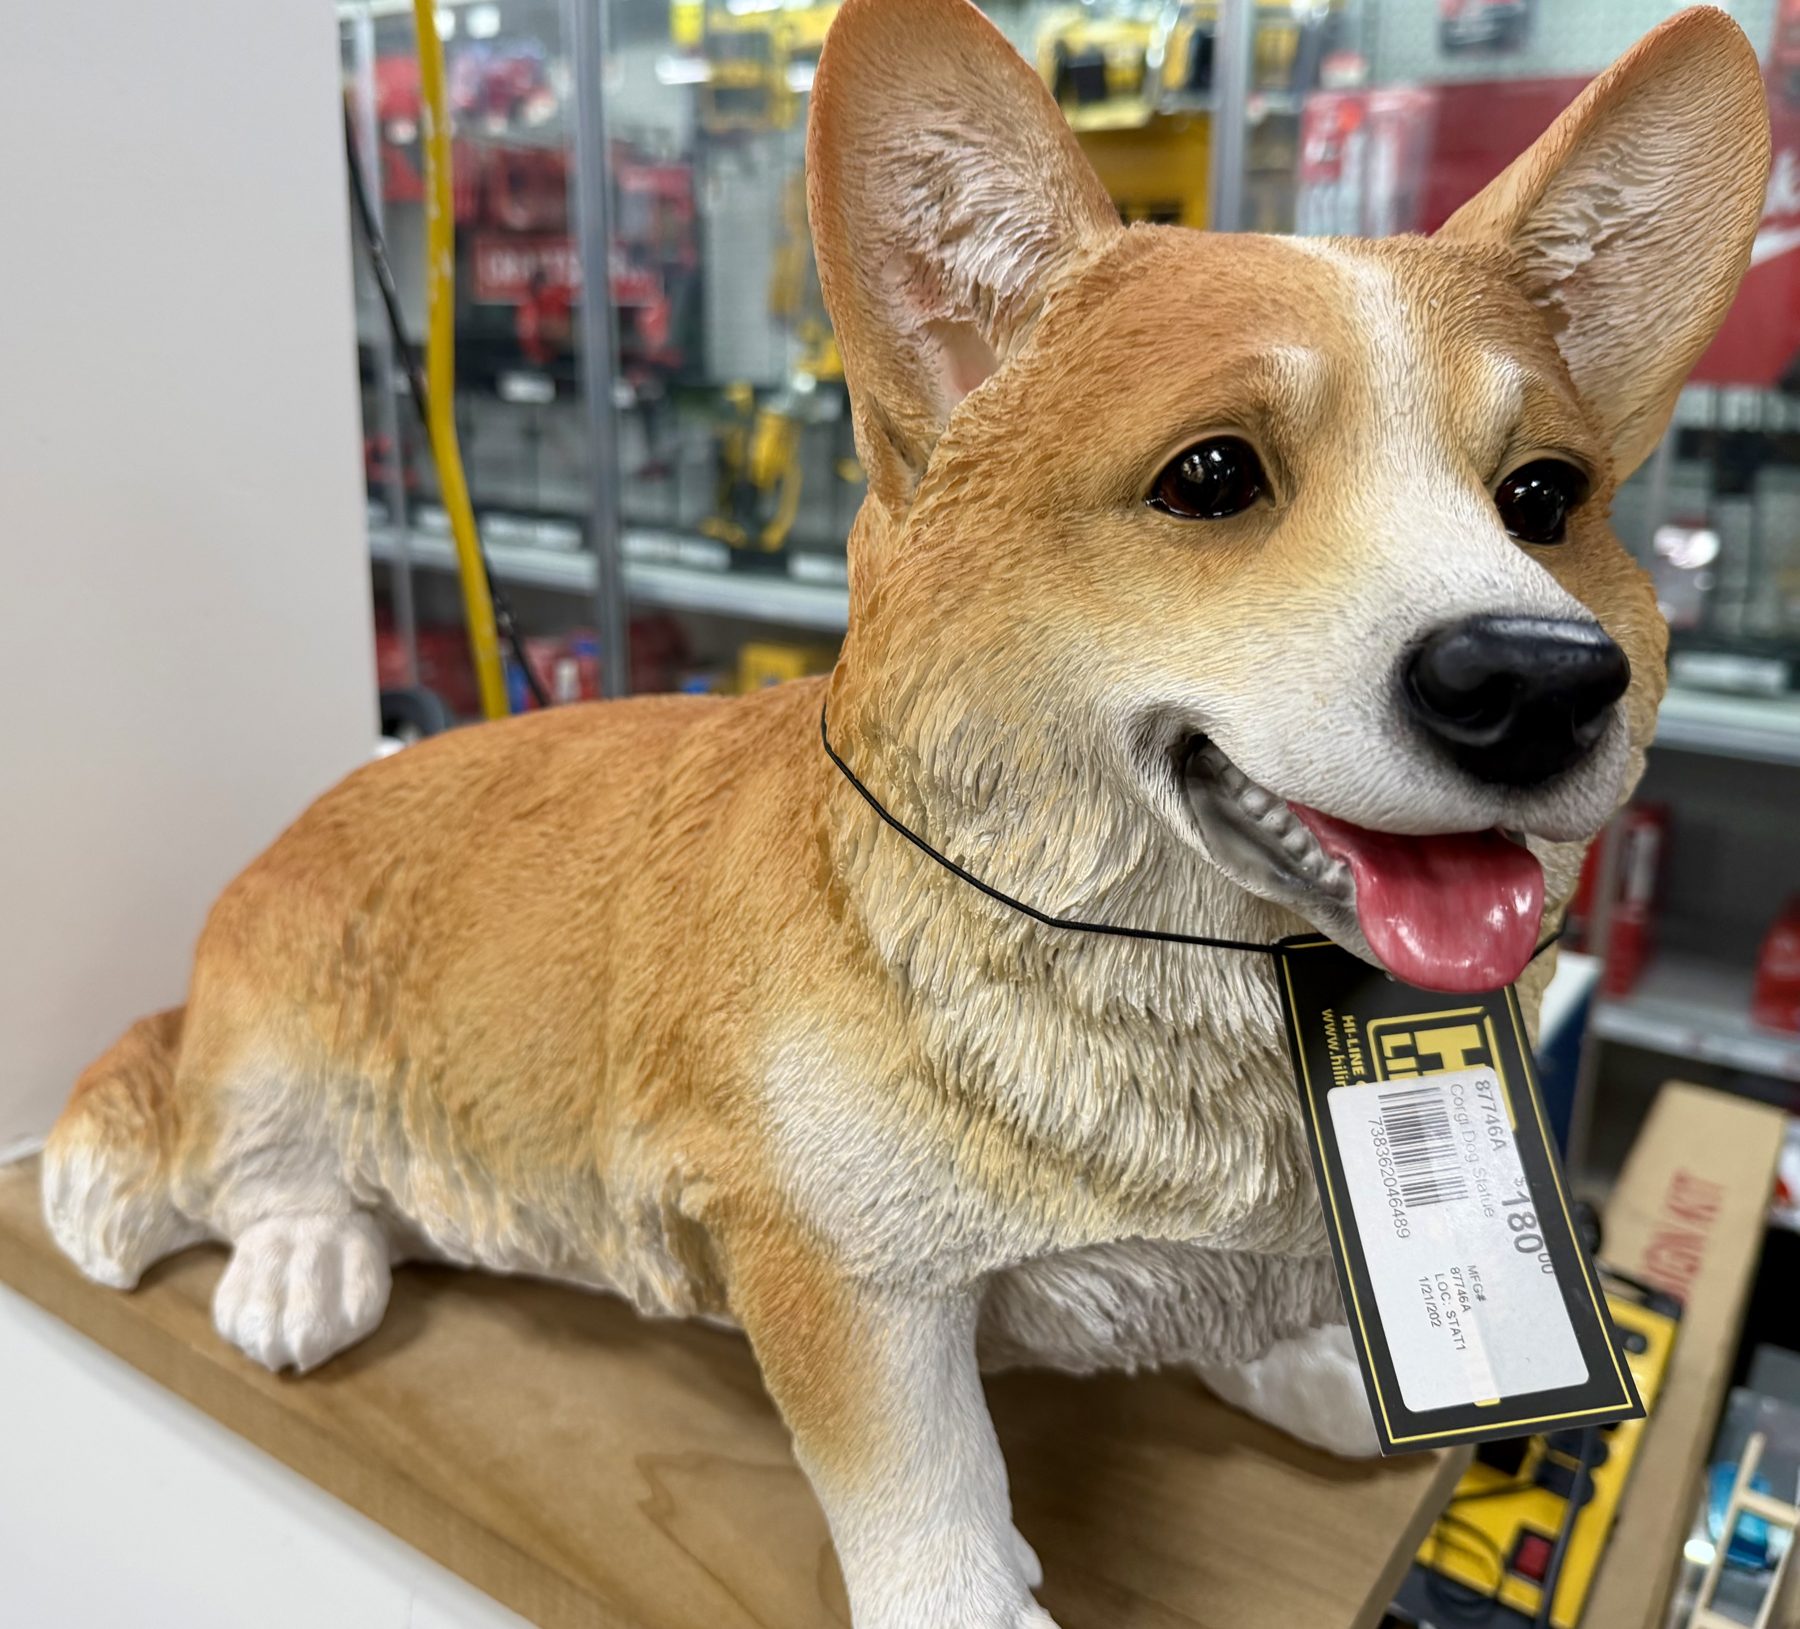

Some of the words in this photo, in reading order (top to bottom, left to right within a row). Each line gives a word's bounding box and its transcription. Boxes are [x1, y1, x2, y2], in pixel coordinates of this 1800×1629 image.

[1342, 1014, 1366, 1076] HI-LINE
[1450, 1083, 1470, 1126] Corgi
[1462, 1130, 1479, 1164] Dog
[1475, 1079, 1507, 1152] 87746A
[1368, 1116, 1411, 1239] 738362046489
[1418, 1276, 1441, 1328] 1/21/202
[1435, 1273, 1452, 1306] LOC:
[1446, 1310, 1466, 1351] STAT1
[1450, 1267, 1472, 1313] 87746A
[1467, 1265, 1486, 1302] MFG#
